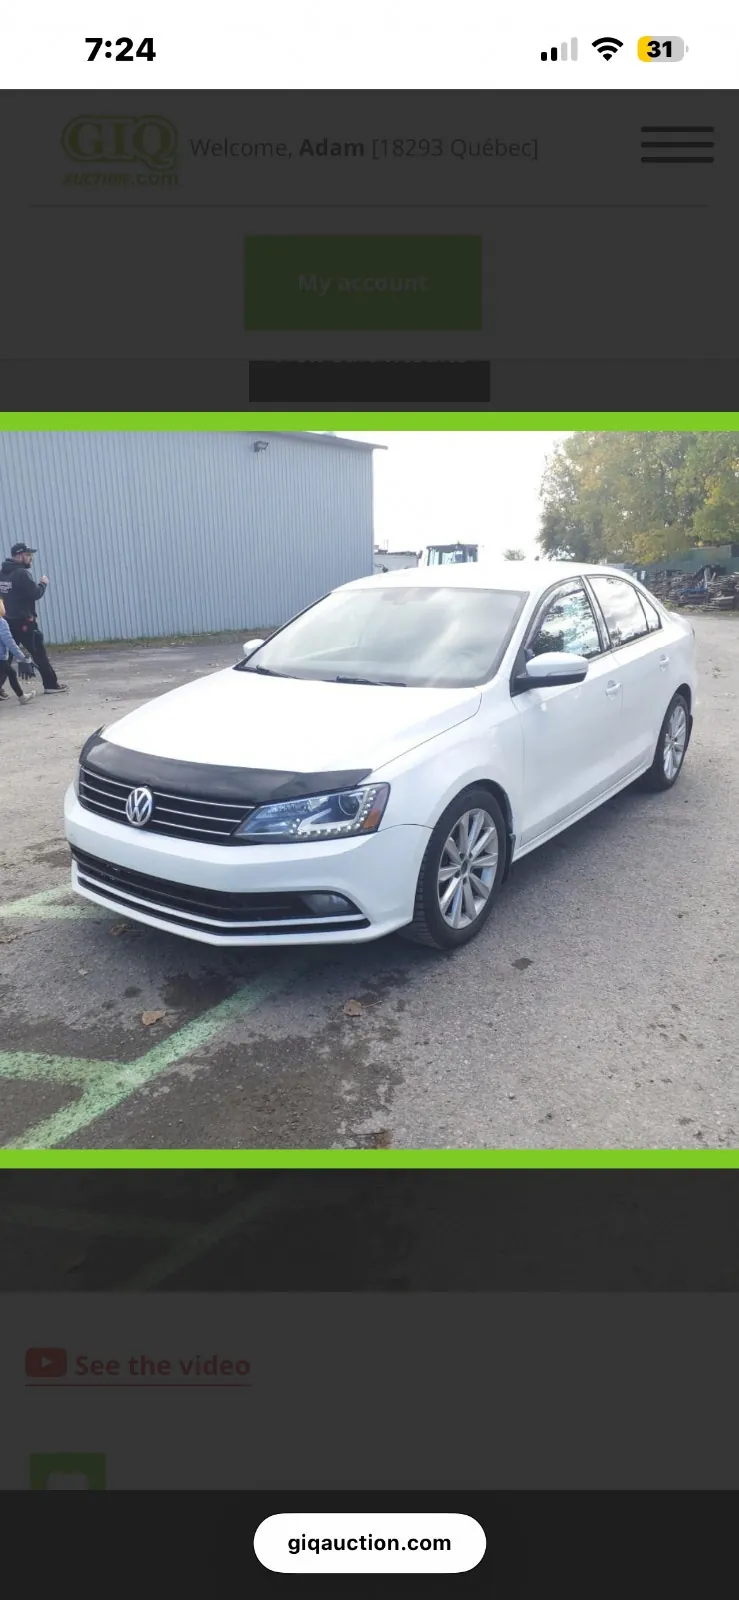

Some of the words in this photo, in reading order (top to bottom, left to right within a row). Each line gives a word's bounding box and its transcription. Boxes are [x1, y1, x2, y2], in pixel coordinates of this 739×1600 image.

[84, 36, 157, 62] 7:24
[646, 40, 673, 59] 31
[65, 118, 176, 168] GIQ
[190, 138, 293, 159] Welcome,
[299, 137, 365, 157] Adam
[372, 138, 443, 161] [18293
[450, 137, 538, 161] Québec]
[298, 274, 331, 295] My
[338, 275, 428, 293] account
[75, 1356, 120, 1376] See
[128, 1355, 171, 1376] the
[179, 1355, 251, 1376] video
[287, 1533, 452, 1555] giqauction.com
